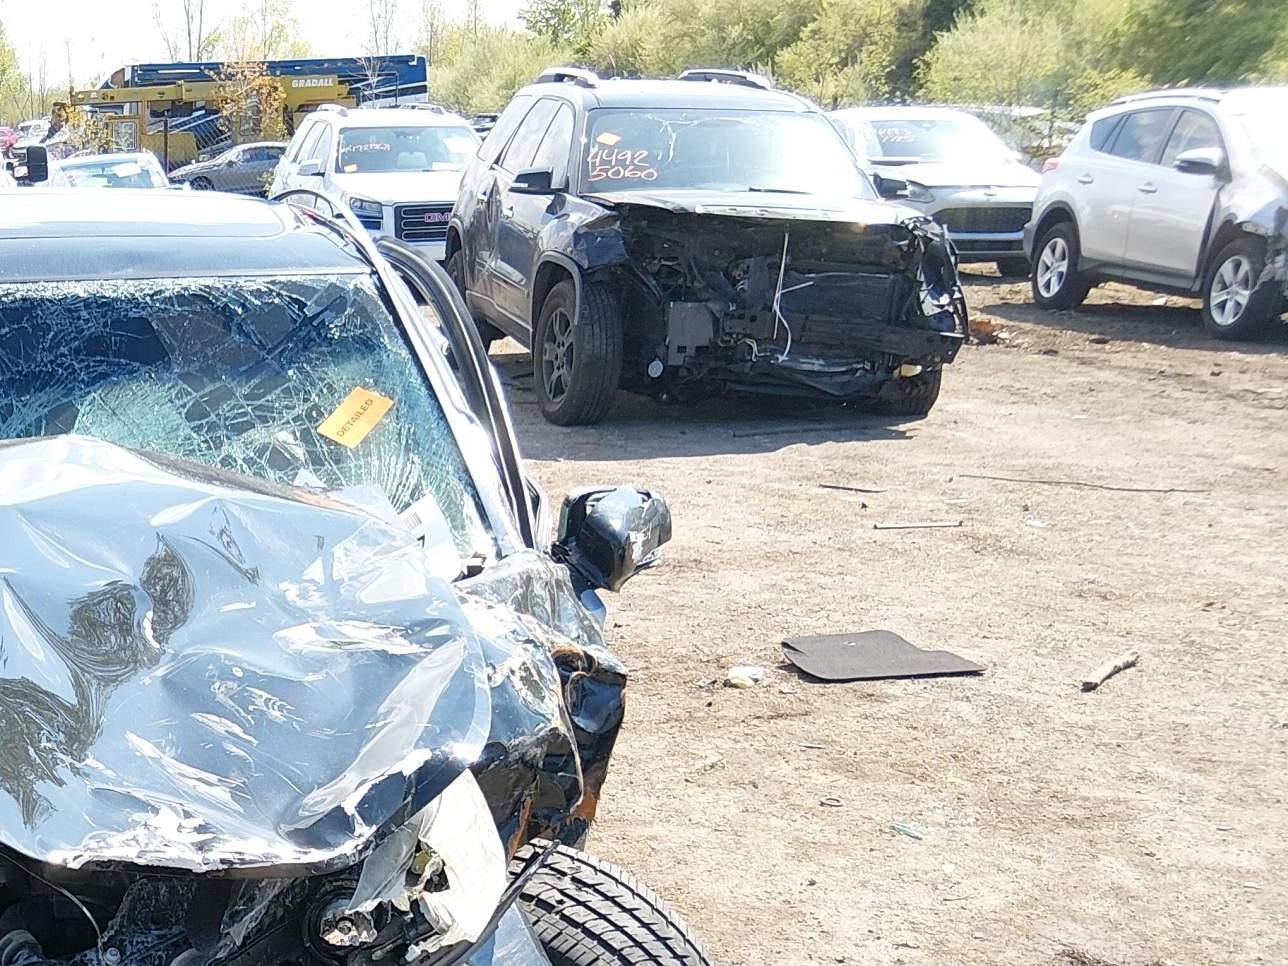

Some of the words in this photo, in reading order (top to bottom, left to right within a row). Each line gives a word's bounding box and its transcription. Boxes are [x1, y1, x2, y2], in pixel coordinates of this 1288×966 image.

[292, 79, 333, 88] GRADALL
[587, 148, 649, 167] 4492
[588, 165, 657, 181] 5060
[337, 398, 374, 437] DETAILED
